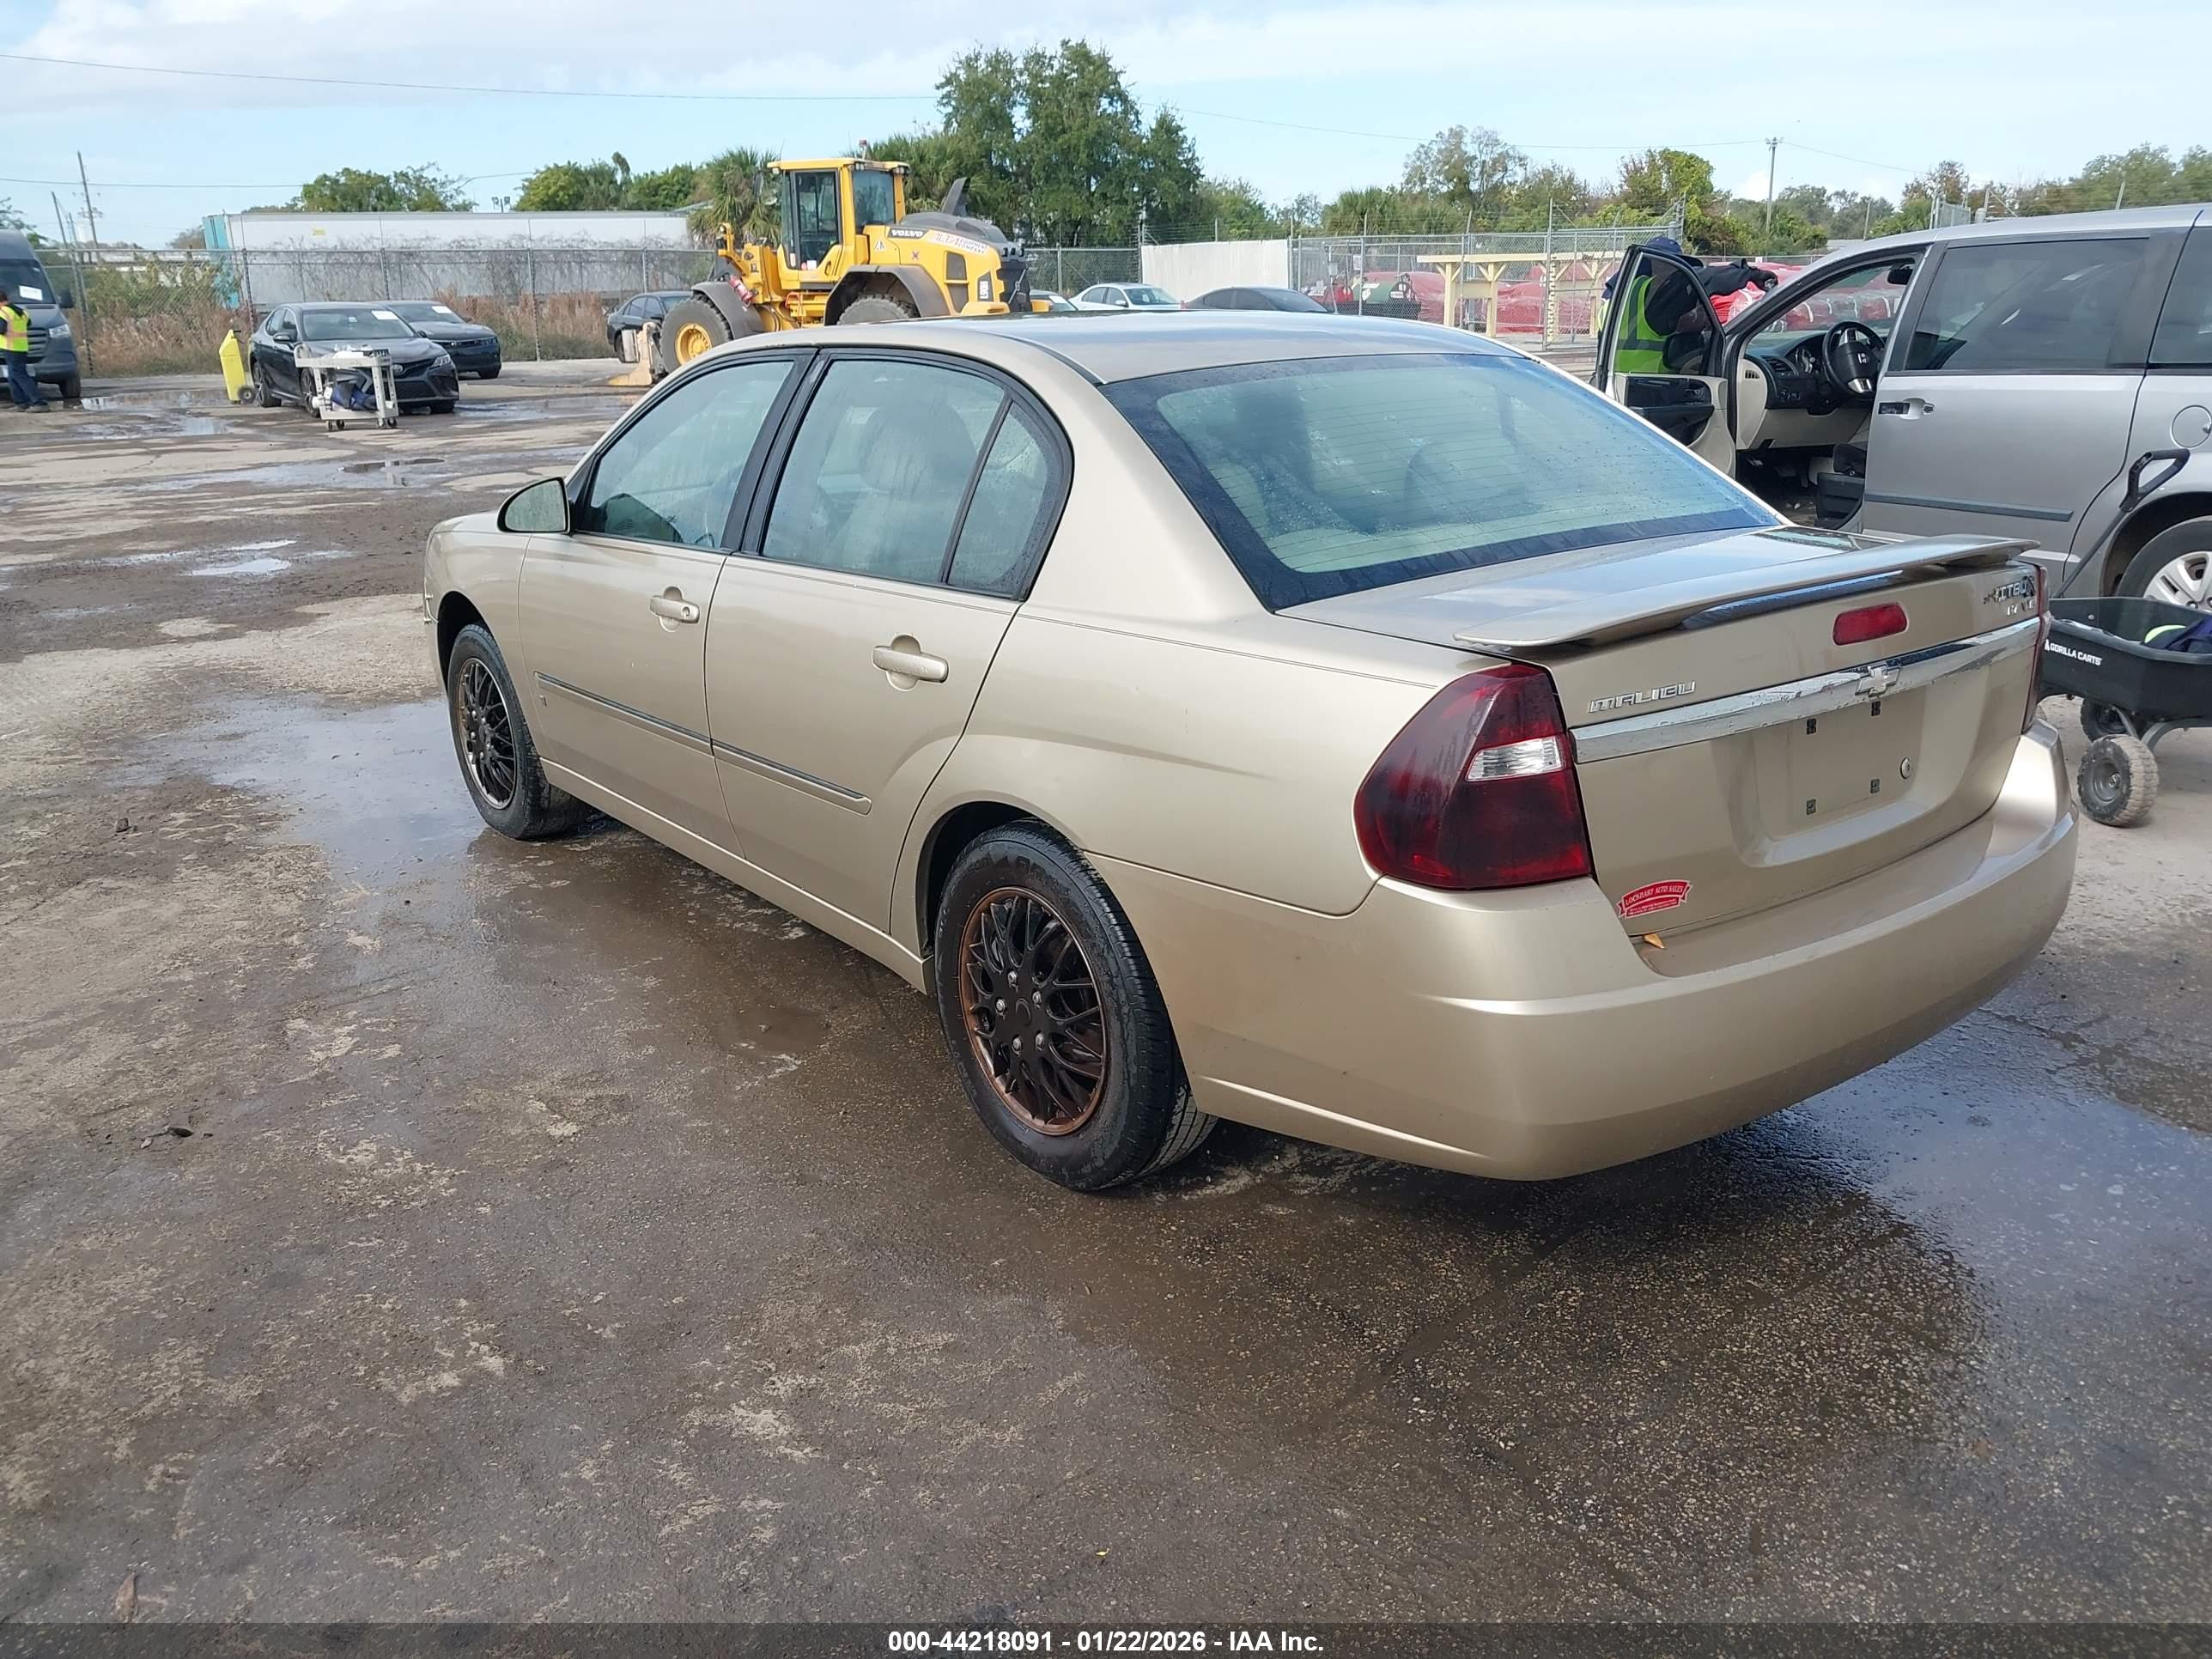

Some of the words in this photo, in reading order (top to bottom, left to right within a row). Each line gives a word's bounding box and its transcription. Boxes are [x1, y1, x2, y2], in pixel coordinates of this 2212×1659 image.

[891, 229, 924, 238] VOLVO
[2050, 642, 2077, 659] GORILLA
[2077, 651, 2102, 666] CARTS
[1588, 680, 1696, 713] MALIBU
[1625, 888, 1655, 906] LOCKHART
[1655, 885, 1668, 895] AUTO
[1668, 884, 1684, 893] SALES
